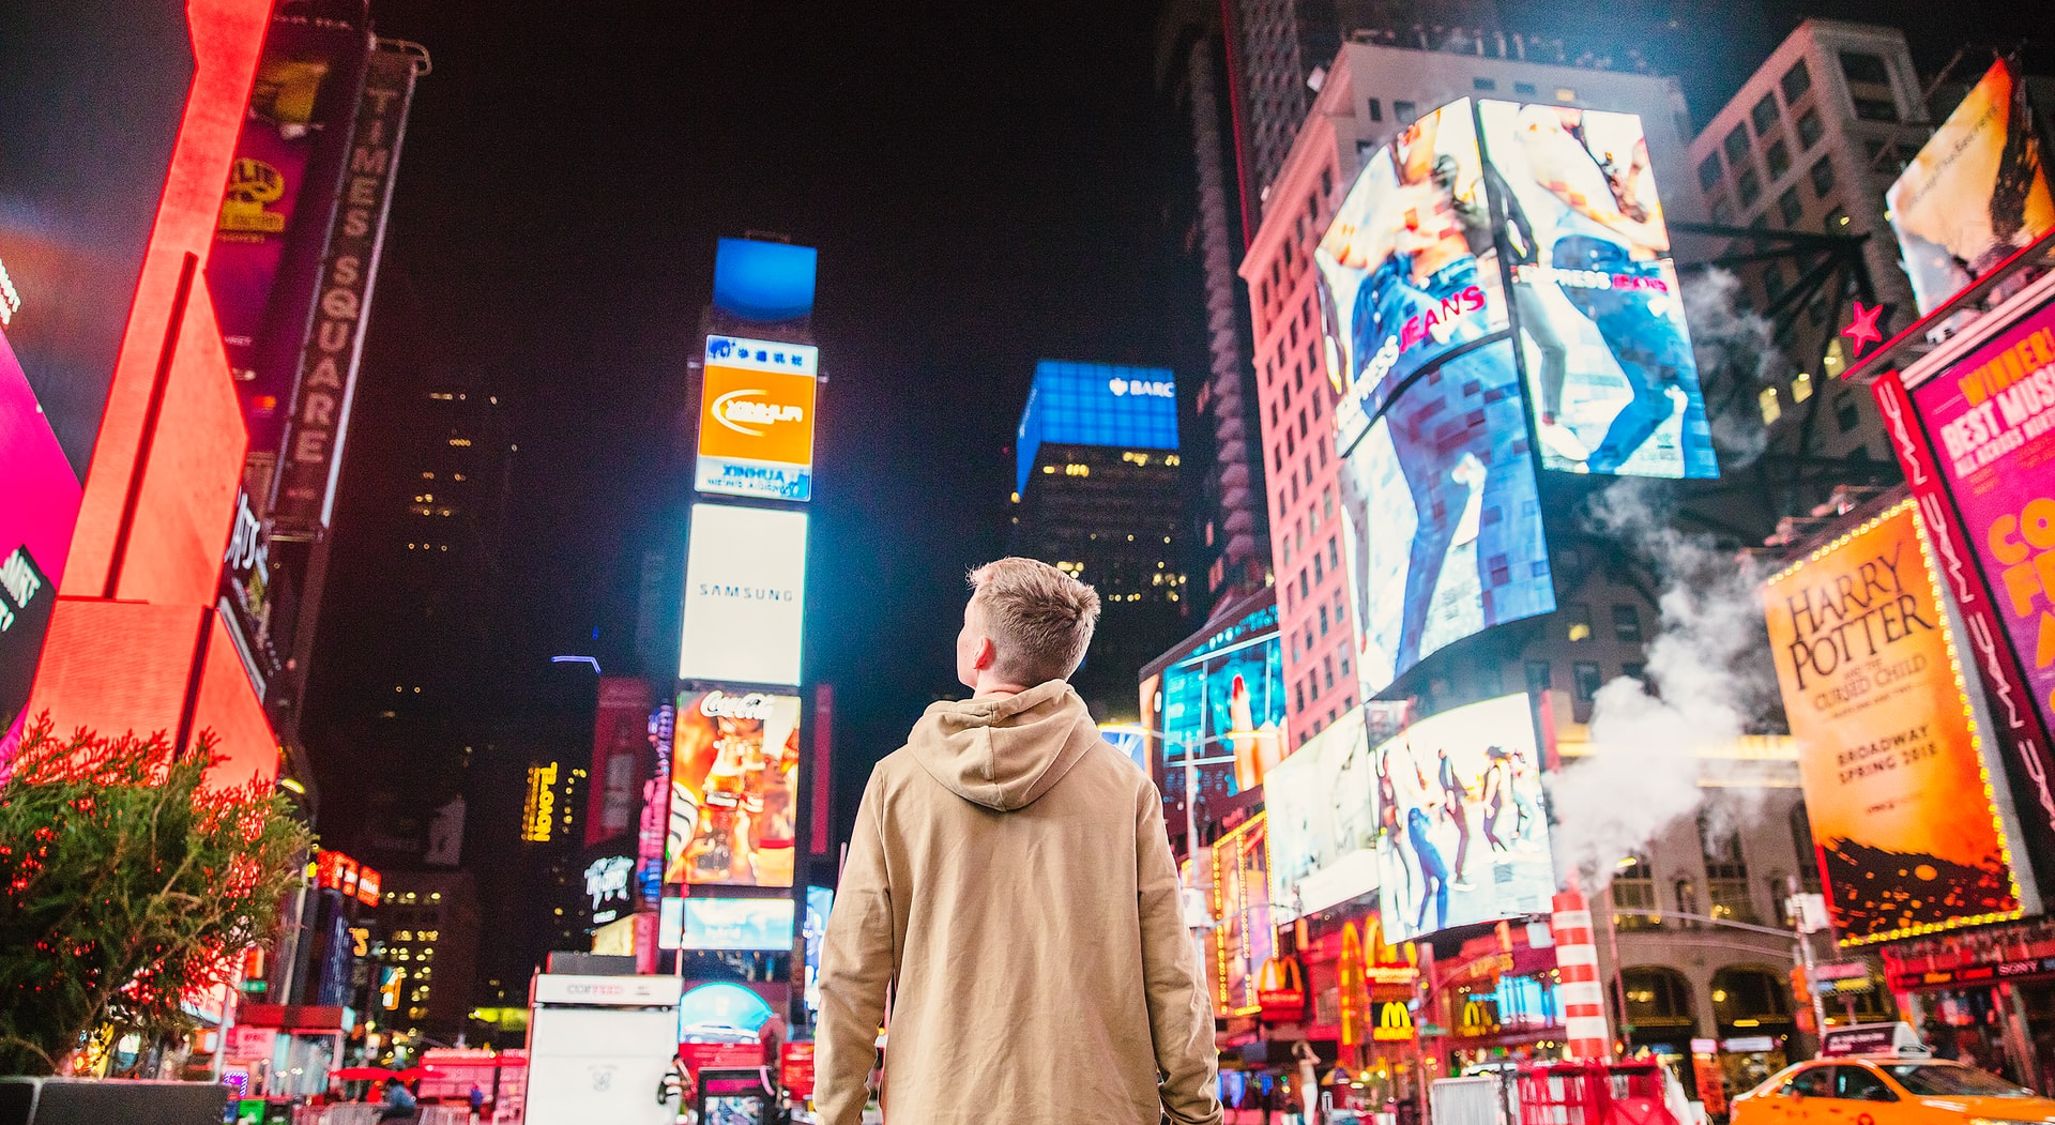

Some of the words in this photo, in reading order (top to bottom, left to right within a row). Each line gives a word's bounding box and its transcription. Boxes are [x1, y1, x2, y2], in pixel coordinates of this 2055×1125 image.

[343, 88, 399, 238] TIMES
[1399, 286, 1486, 353] JEANS
[297, 255, 361, 464] SQUARE
[1939, 400, 2002, 462] BEST
[699, 583, 793, 602] SAMSUNG
[1786, 541, 1902, 641] HARRY
[1788, 593, 1935, 692] POTTER
[1875, 652, 1927, 687] CHILD
[1837, 724, 1929, 768] BROADWAY
[1838, 755, 1897, 785] SPRING
[533, 761, 558, 842] NOVOTEL
[1998, 960, 2038, 976] SONY
